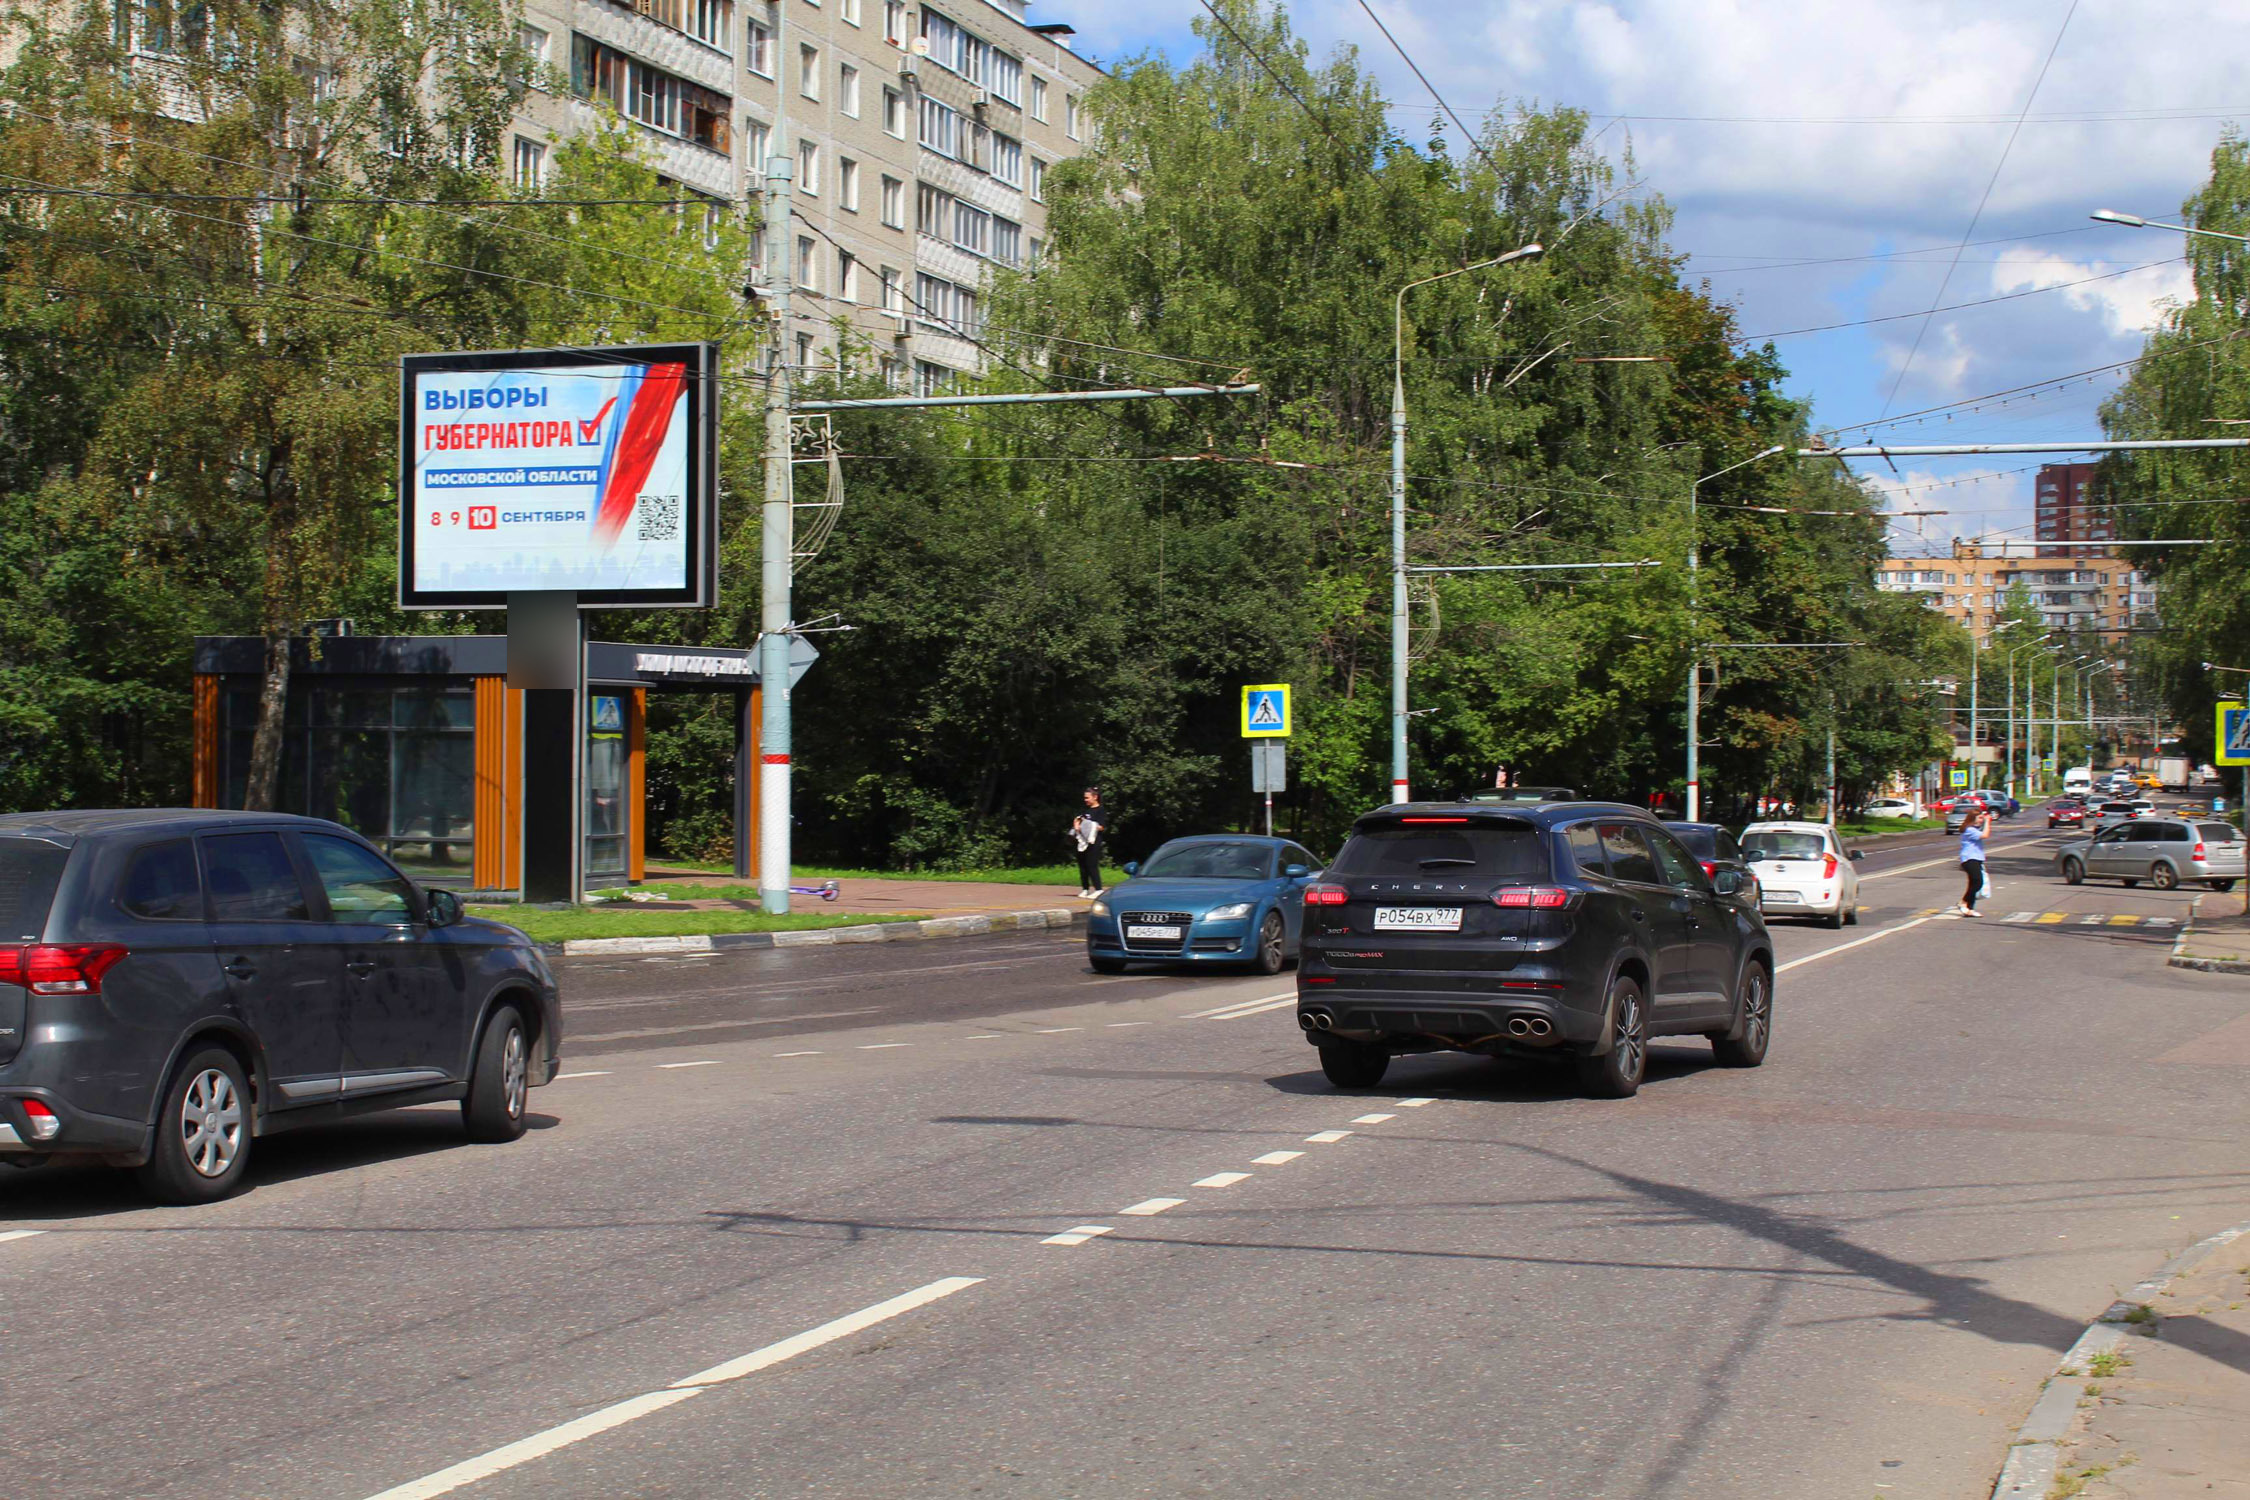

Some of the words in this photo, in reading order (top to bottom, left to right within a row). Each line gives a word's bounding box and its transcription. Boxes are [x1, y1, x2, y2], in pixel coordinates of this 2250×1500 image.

[425, 387, 547, 410] ВЫБОРЫ
[424, 421, 573, 451] ГУБЕРНАТОРА
[427, 469, 526, 485] МОСКОВСКОЙ
[528, 470, 598, 483] ОБЛАСТИ
[431, 512, 441, 526] 8
[451, 512, 460, 525] 9
[471, 508, 493, 527] 10
[502, 511, 586, 523] СЕНТЯБРЯ
[1436, 908, 1458, 919] 977
